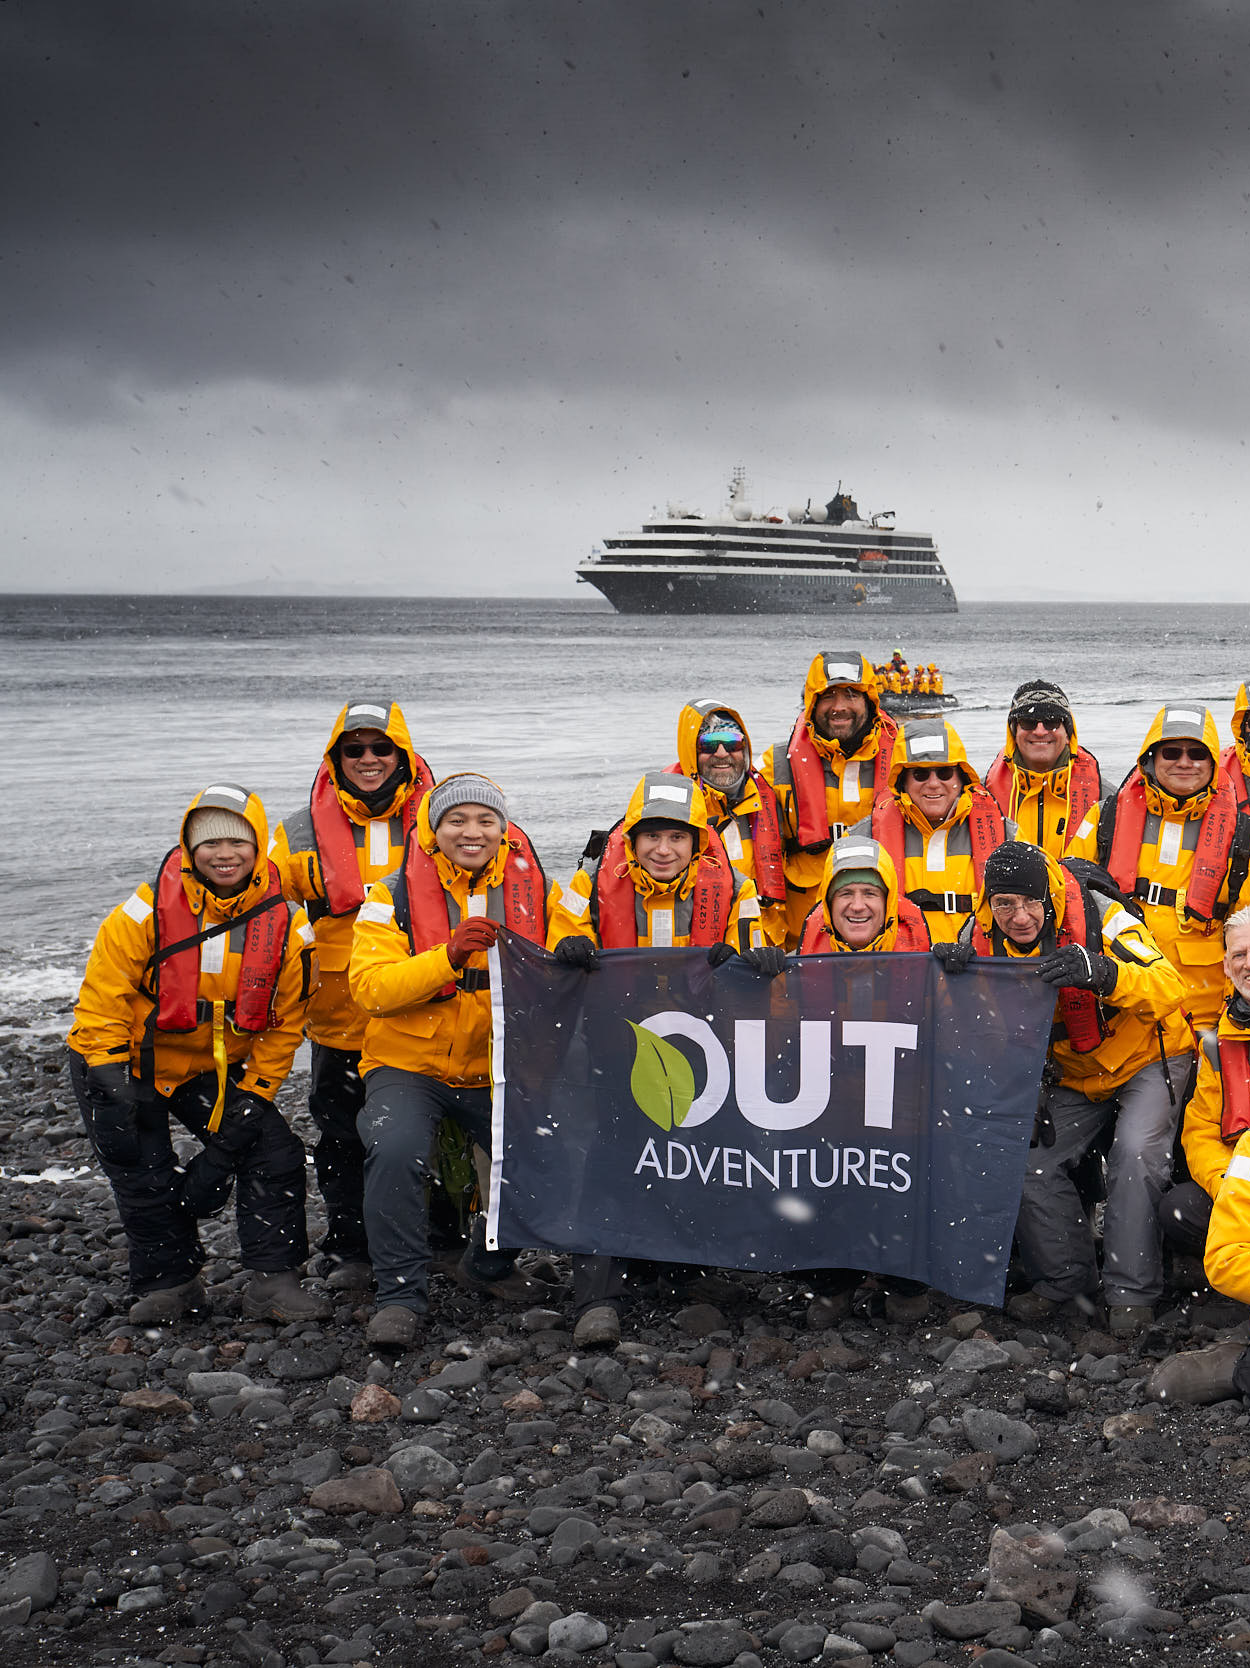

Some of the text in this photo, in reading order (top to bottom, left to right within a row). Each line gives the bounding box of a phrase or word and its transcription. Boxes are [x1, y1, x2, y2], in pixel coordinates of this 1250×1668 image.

[1071, 790, 1079, 824] CE275N
[1203, 812, 1216, 847] CE275N
[512, 883, 522, 925] CE275N
[699, 888, 708, 930] CE275N
[636, 1010, 918, 1131] OUT
[633, 1137, 912, 1193] ADVENTURES
